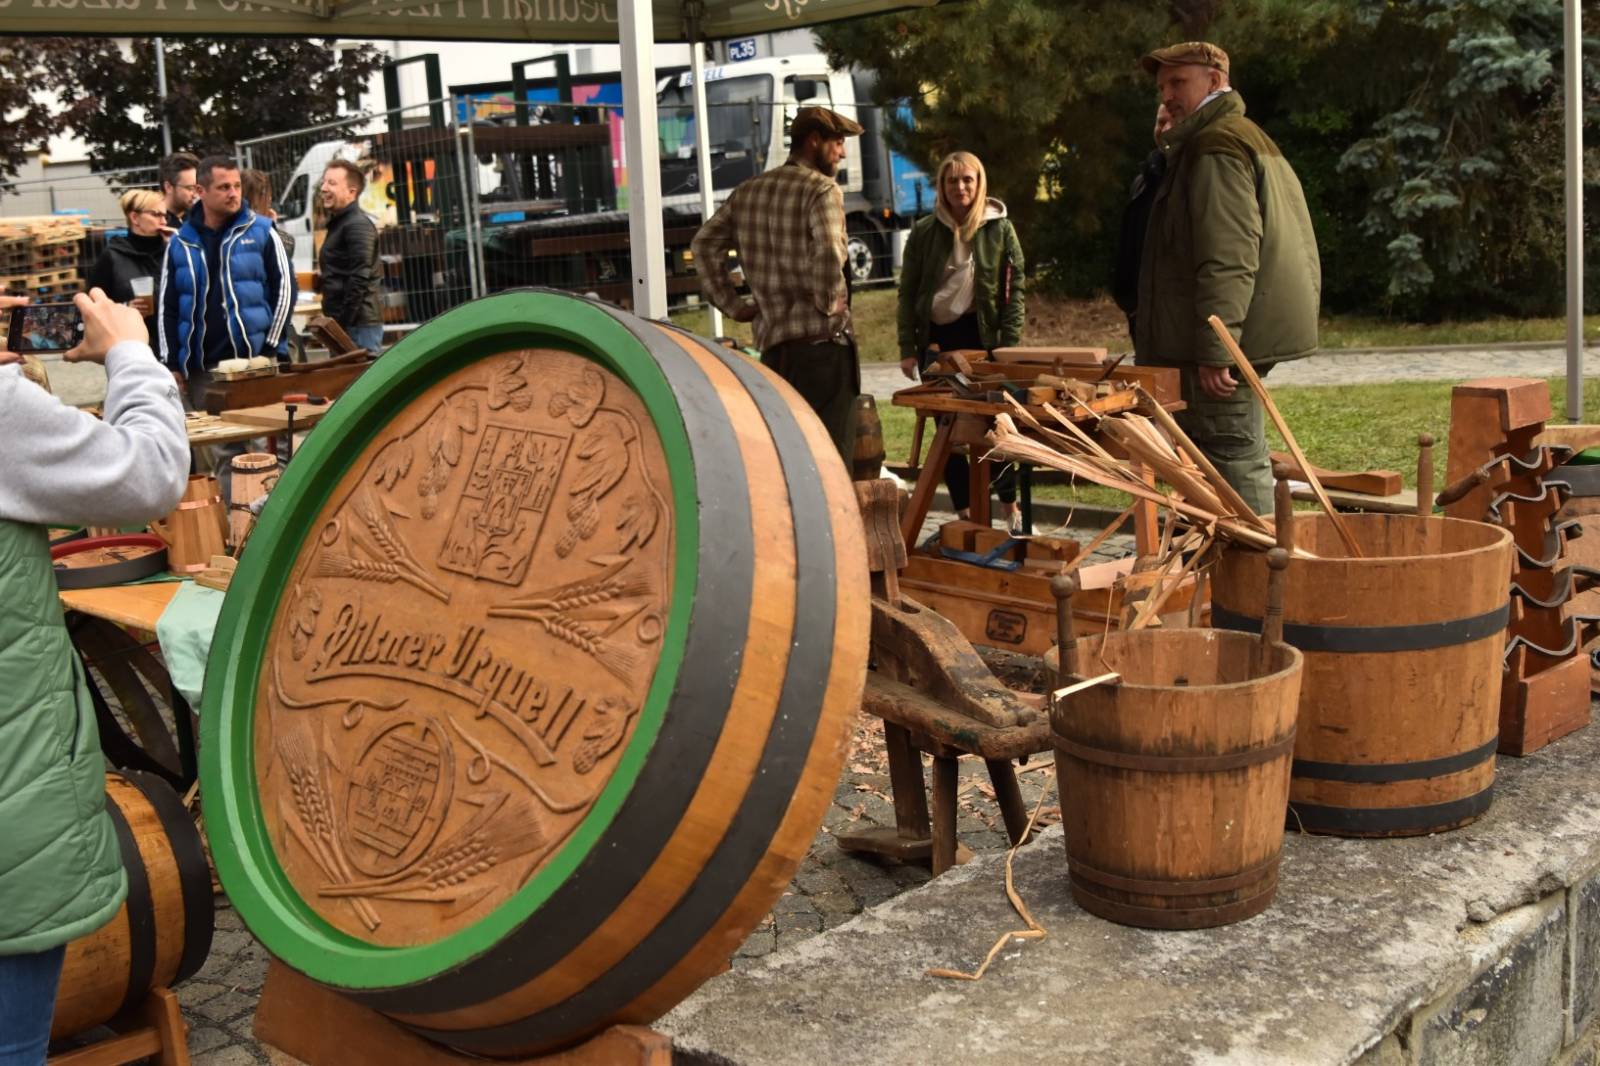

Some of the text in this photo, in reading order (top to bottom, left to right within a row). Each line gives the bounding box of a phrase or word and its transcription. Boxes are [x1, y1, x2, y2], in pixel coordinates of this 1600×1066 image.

[730, 39, 754, 59] PL35
[313, 592, 586, 751] Pilsner Urquell
